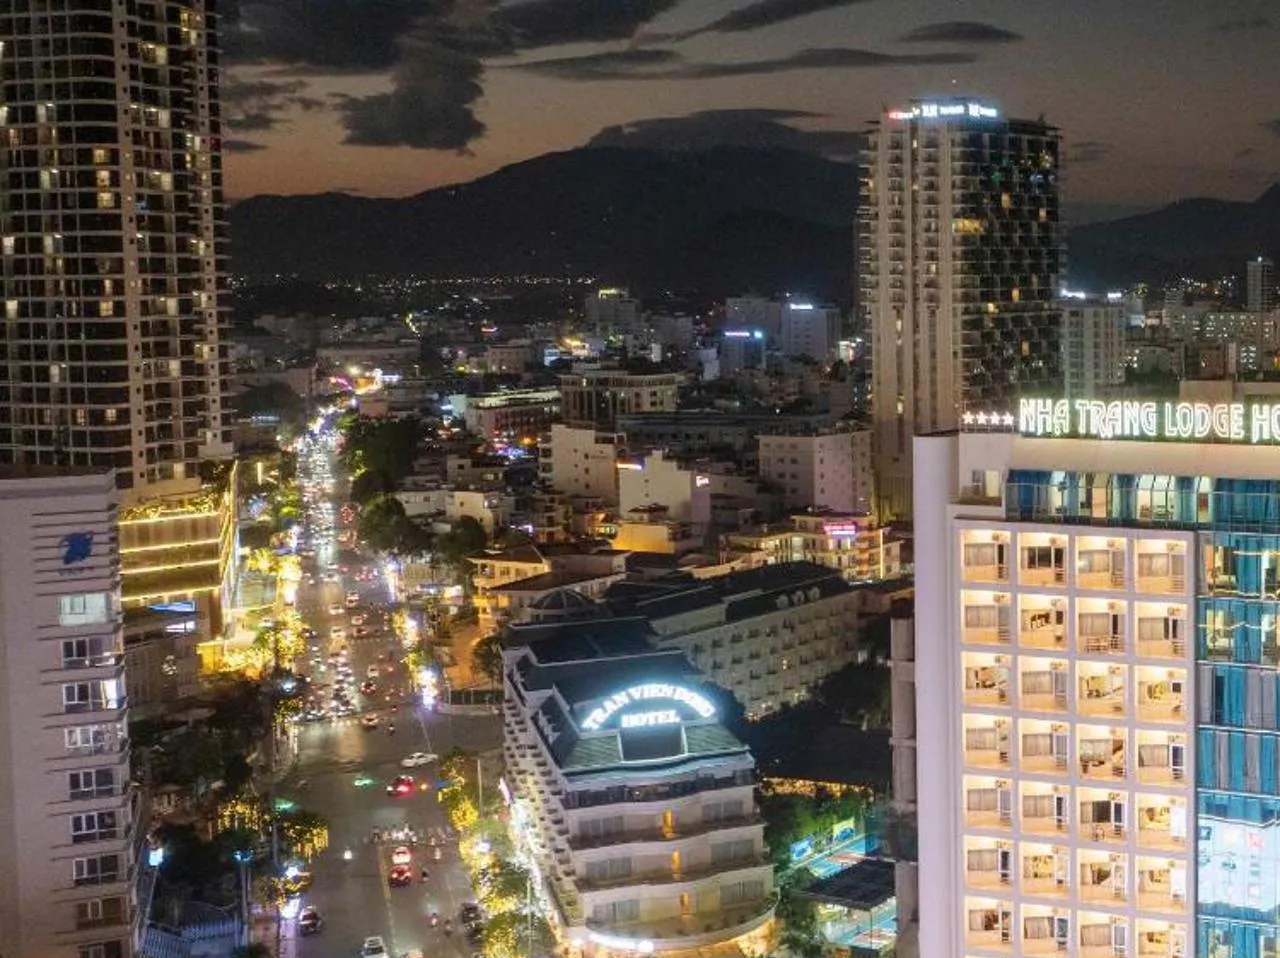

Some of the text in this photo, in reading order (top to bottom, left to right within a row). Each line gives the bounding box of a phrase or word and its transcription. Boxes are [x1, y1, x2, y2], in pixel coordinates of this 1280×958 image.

[1019, 397, 1070, 437] NHA
[1075, 399, 1157, 438] TRANG
[1164, 402, 1245, 439] LODGE
[621, 710, 680, 728] HOTEL
